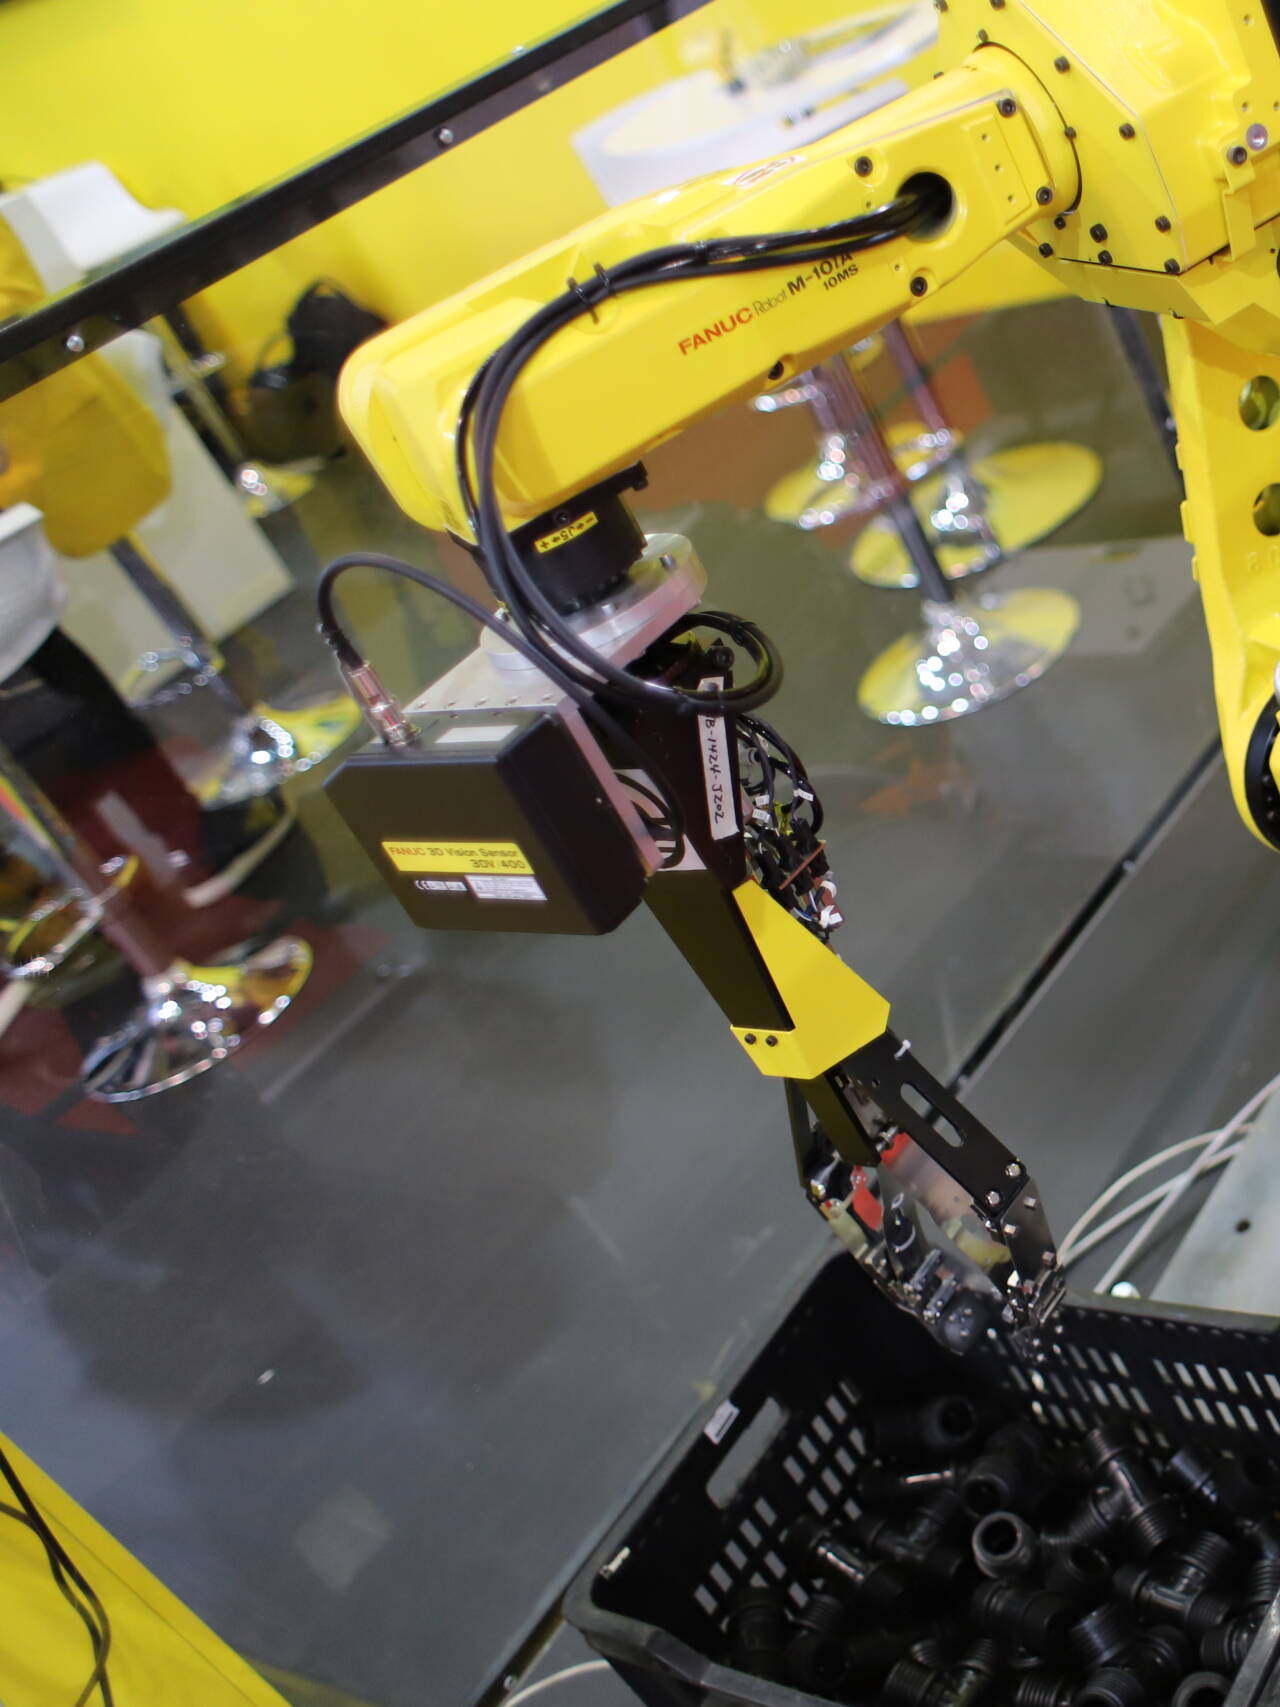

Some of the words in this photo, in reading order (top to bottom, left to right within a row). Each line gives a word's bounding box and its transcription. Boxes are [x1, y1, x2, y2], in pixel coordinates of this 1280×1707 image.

[822, 264, 859, 290] 10MS
[678, 307, 753, 355] FANUC
[752, 289, 788, 316] Robot
[388, 847, 426, 857] FANUC
[428, 847, 444, 857] 3D
[446, 847, 478, 857] Vision
[480, 848, 518, 858] Sensor
